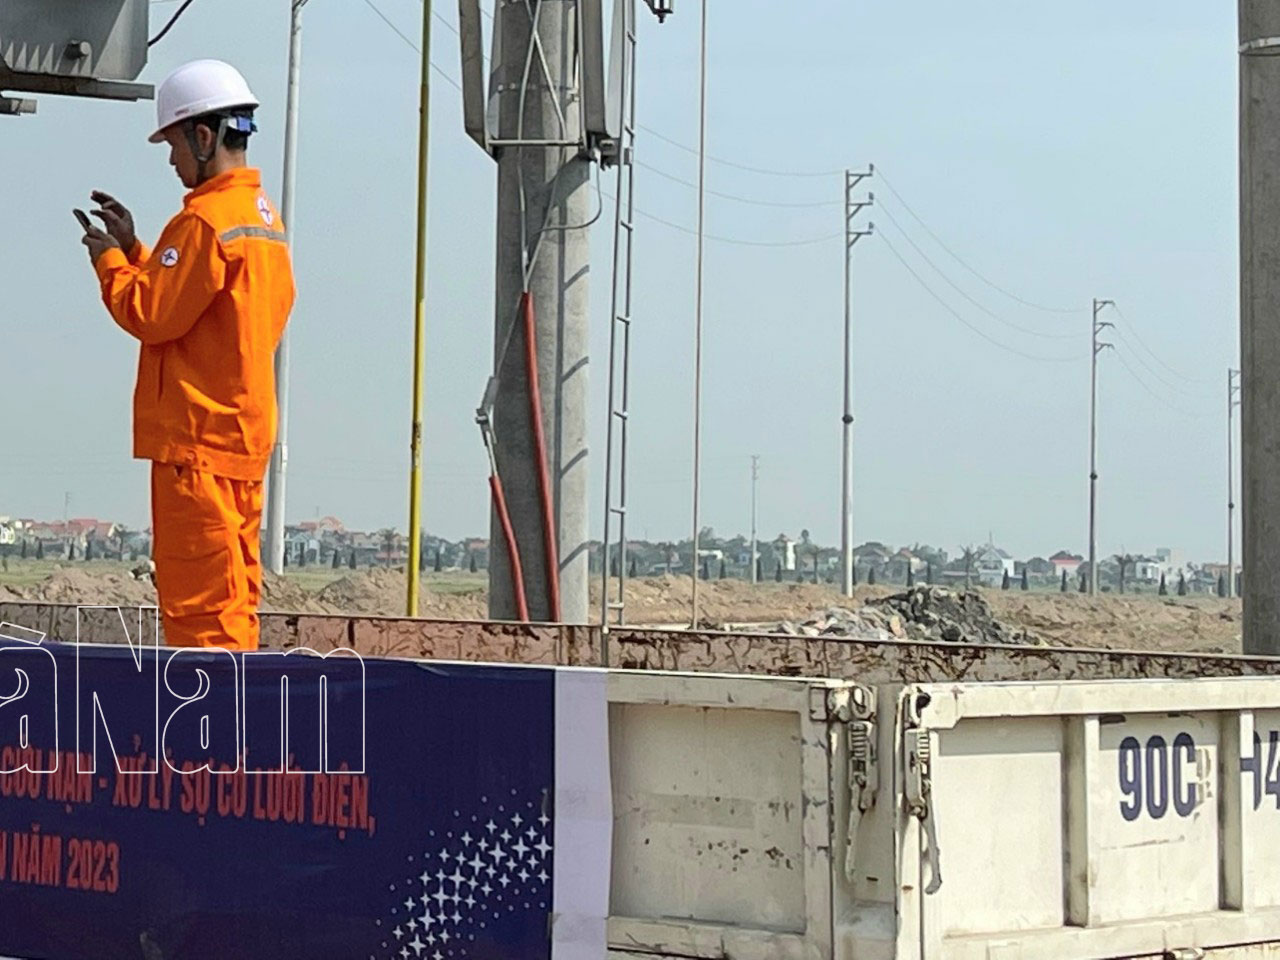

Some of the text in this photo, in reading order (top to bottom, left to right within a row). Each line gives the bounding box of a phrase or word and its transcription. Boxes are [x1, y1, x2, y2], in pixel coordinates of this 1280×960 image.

[47, 750, 93, 813] NẠN
[148, 747, 174, 811] LÝ
[180, 756, 214, 826] SỰ
[217, 745, 249, 818] CỐ
[1118, 731, 1197, 821] 90C
[12, 822, 62, 885] NĂM
[67, 838, 120, 893] 2023
